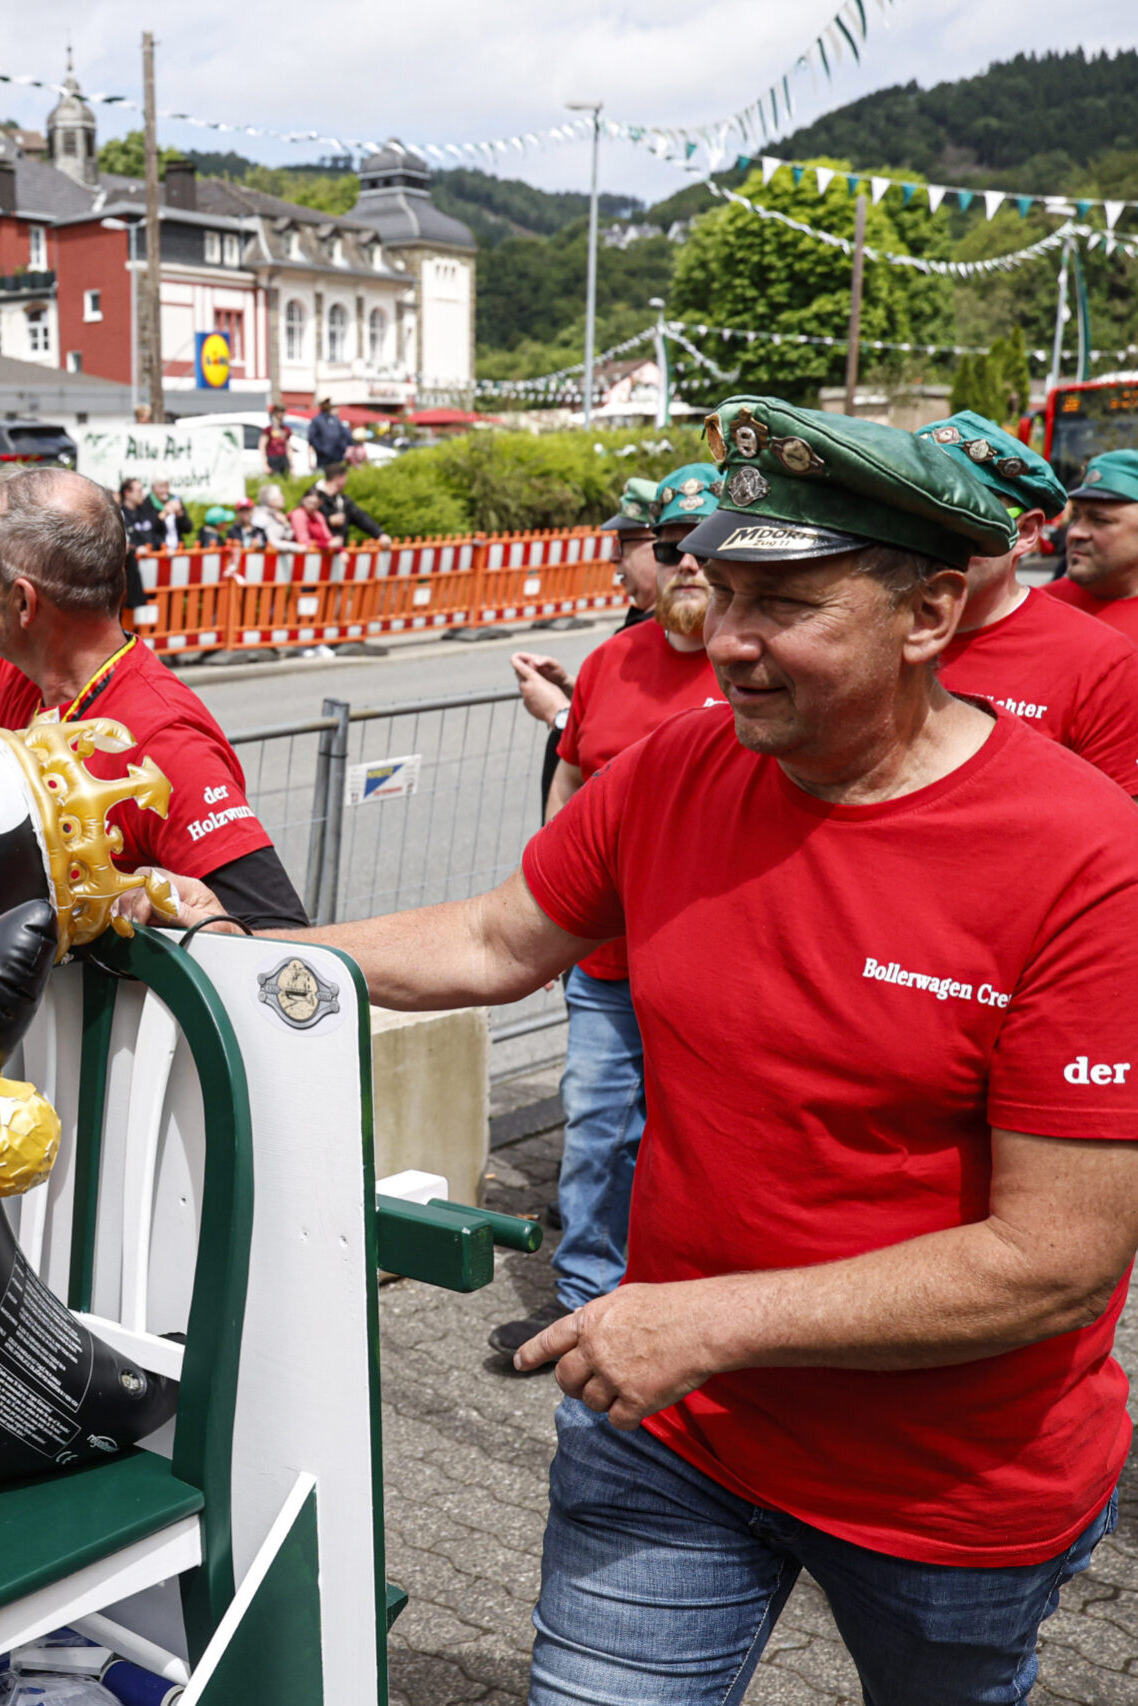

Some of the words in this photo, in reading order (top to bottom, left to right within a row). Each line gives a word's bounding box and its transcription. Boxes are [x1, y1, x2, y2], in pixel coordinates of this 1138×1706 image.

[164, 435, 192, 460] Art
[203, 785, 229, 804] der
[863, 958, 972, 1000] Bollerwagen
[977, 983, 1012, 1008] Cre
[1063, 1056, 1131, 1085] der
